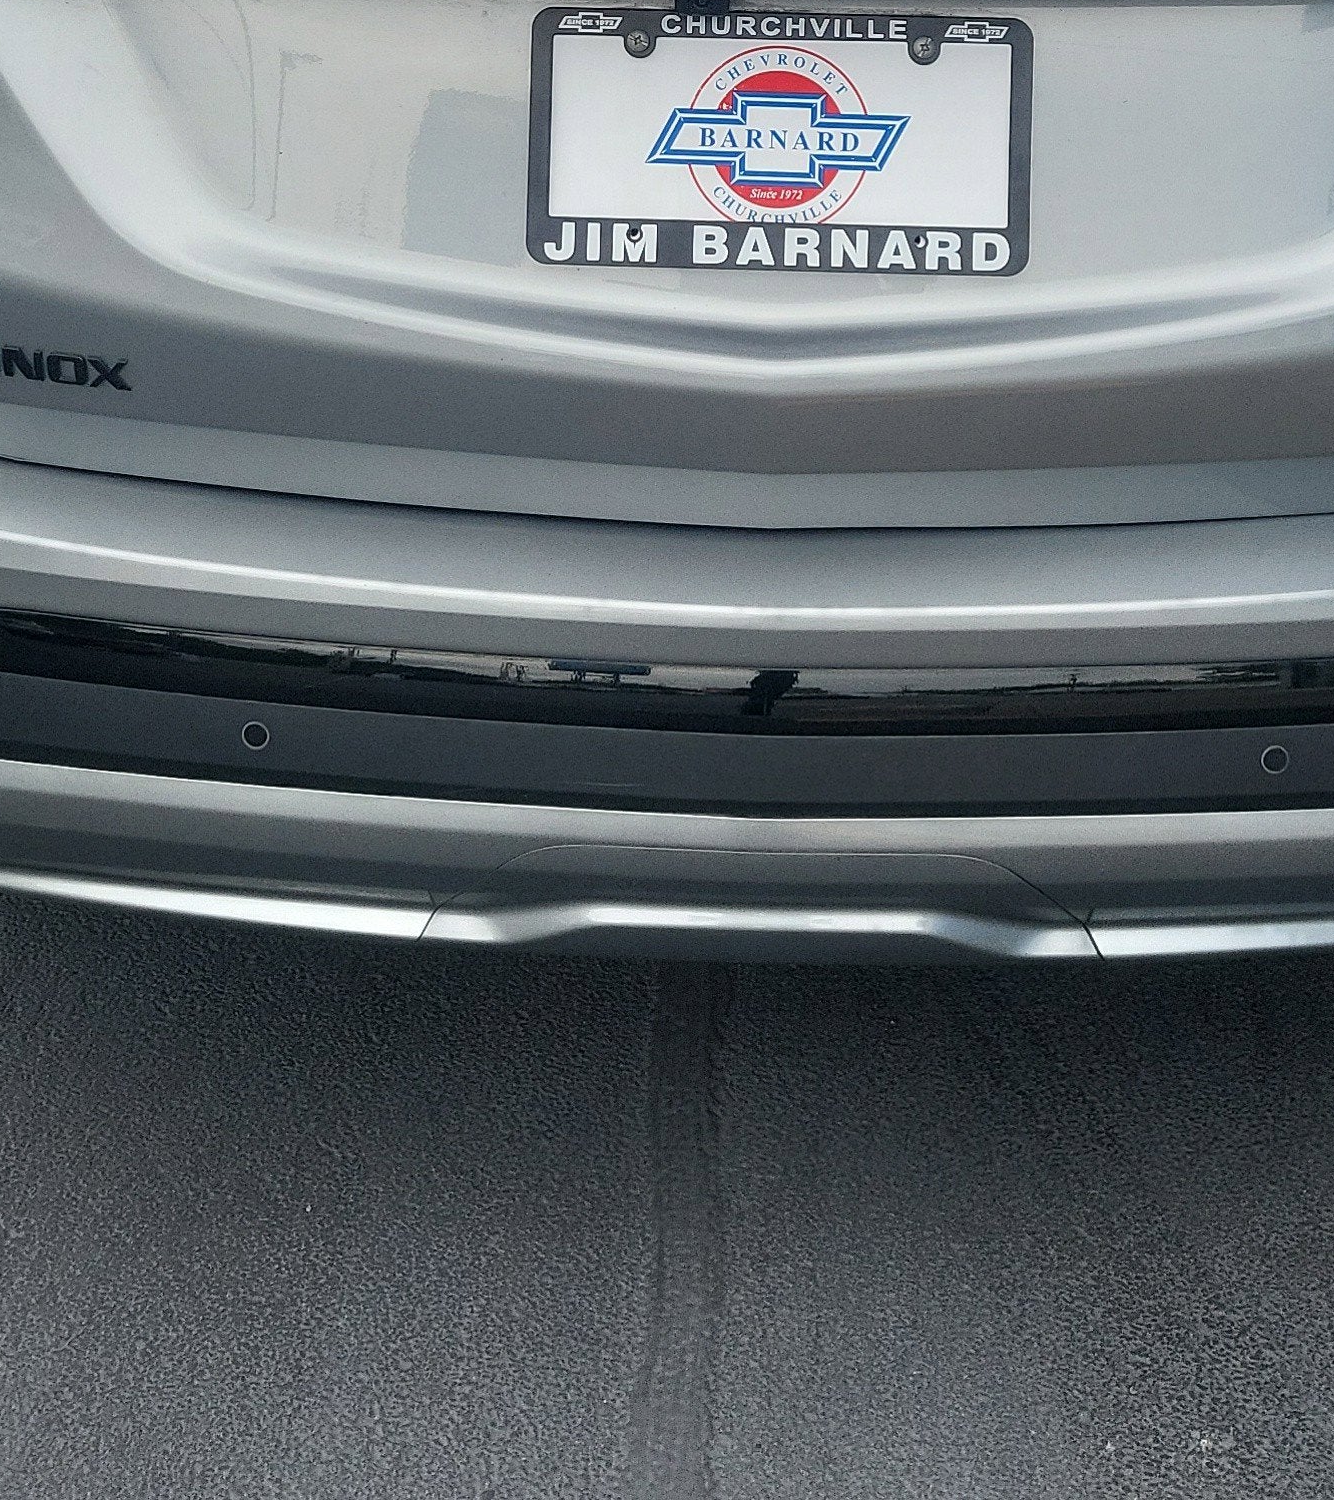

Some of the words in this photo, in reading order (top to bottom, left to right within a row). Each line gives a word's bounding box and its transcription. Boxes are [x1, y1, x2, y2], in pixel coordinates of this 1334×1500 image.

[566, 18, 593, 26] SINCE
[661, 14, 908, 40] CHURCHVILLE
[981, 28, 1001, 36] 1972
[715, 53, 849, 95] CHEVROLET
[699, 126, 860, 152] BARNARD
[749, 188, 778, 200] Since
[779, 189, 804, 200] 1972
[544, 221, 659, 263] JIM
[691, 223, 1011, 272] BARNARD
